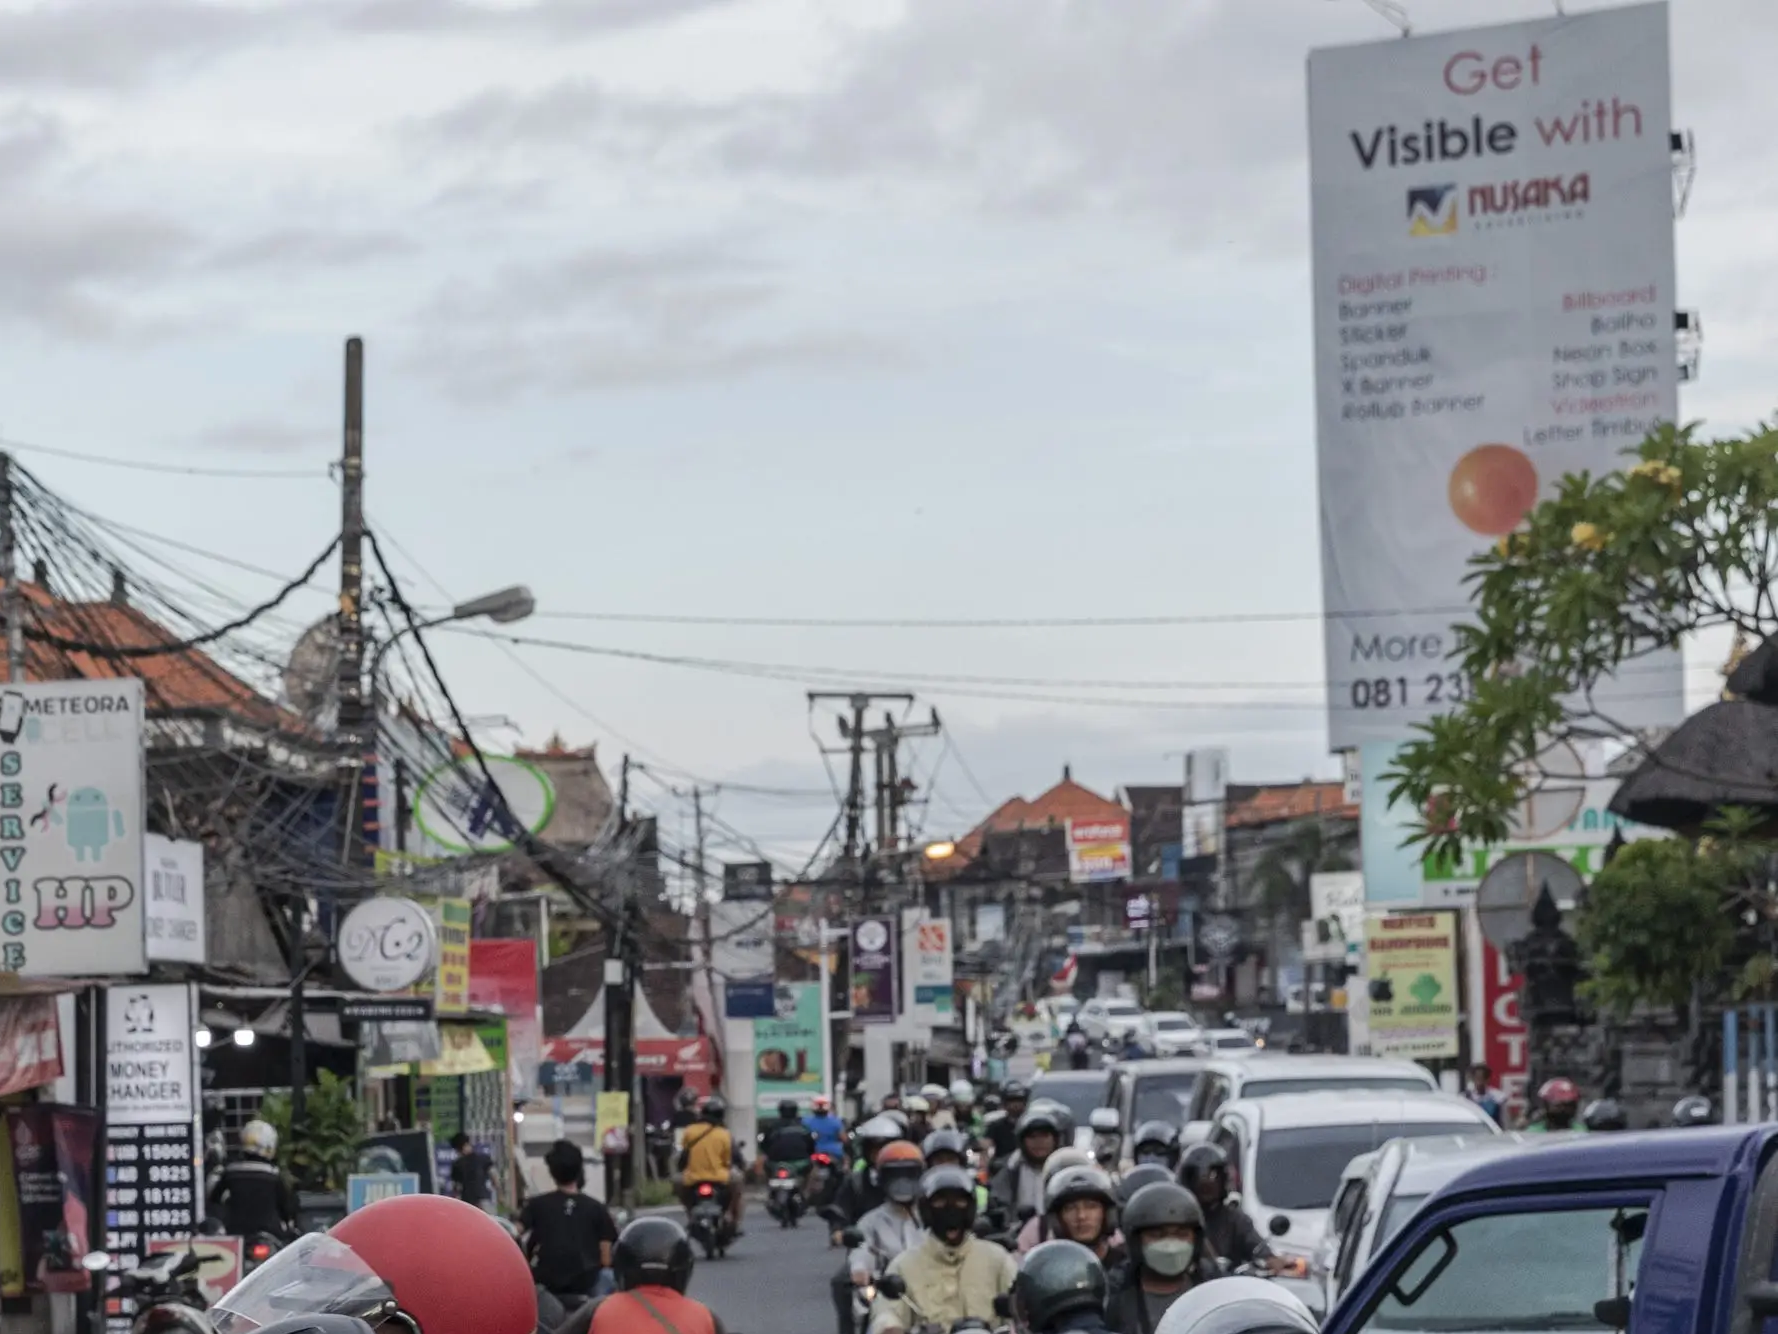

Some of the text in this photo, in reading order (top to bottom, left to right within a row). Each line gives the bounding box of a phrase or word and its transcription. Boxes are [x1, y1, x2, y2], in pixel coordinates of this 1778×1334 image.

[1443, 44, 1544, 96] Get
[1350, 97, 1643, 170] Visible with
[1338, 273, 1404, 295] Digital
[1338, 299, 1412, 321] Banner
[1359, 374, 1434, 395] Banner
[1411, 394, 1485, 416] Banner
[1523, 424, 1584, 446] Letter
[1351, 632, 1442, 662] More
[1351, 676, 1408, 708] 081
[23, 696, 130, 716] METEORA
[33, 876, 134, 929] HP
[110, 1060, 170, 1079] MONEY
[110, 1082, 181, 1100] HANGER
